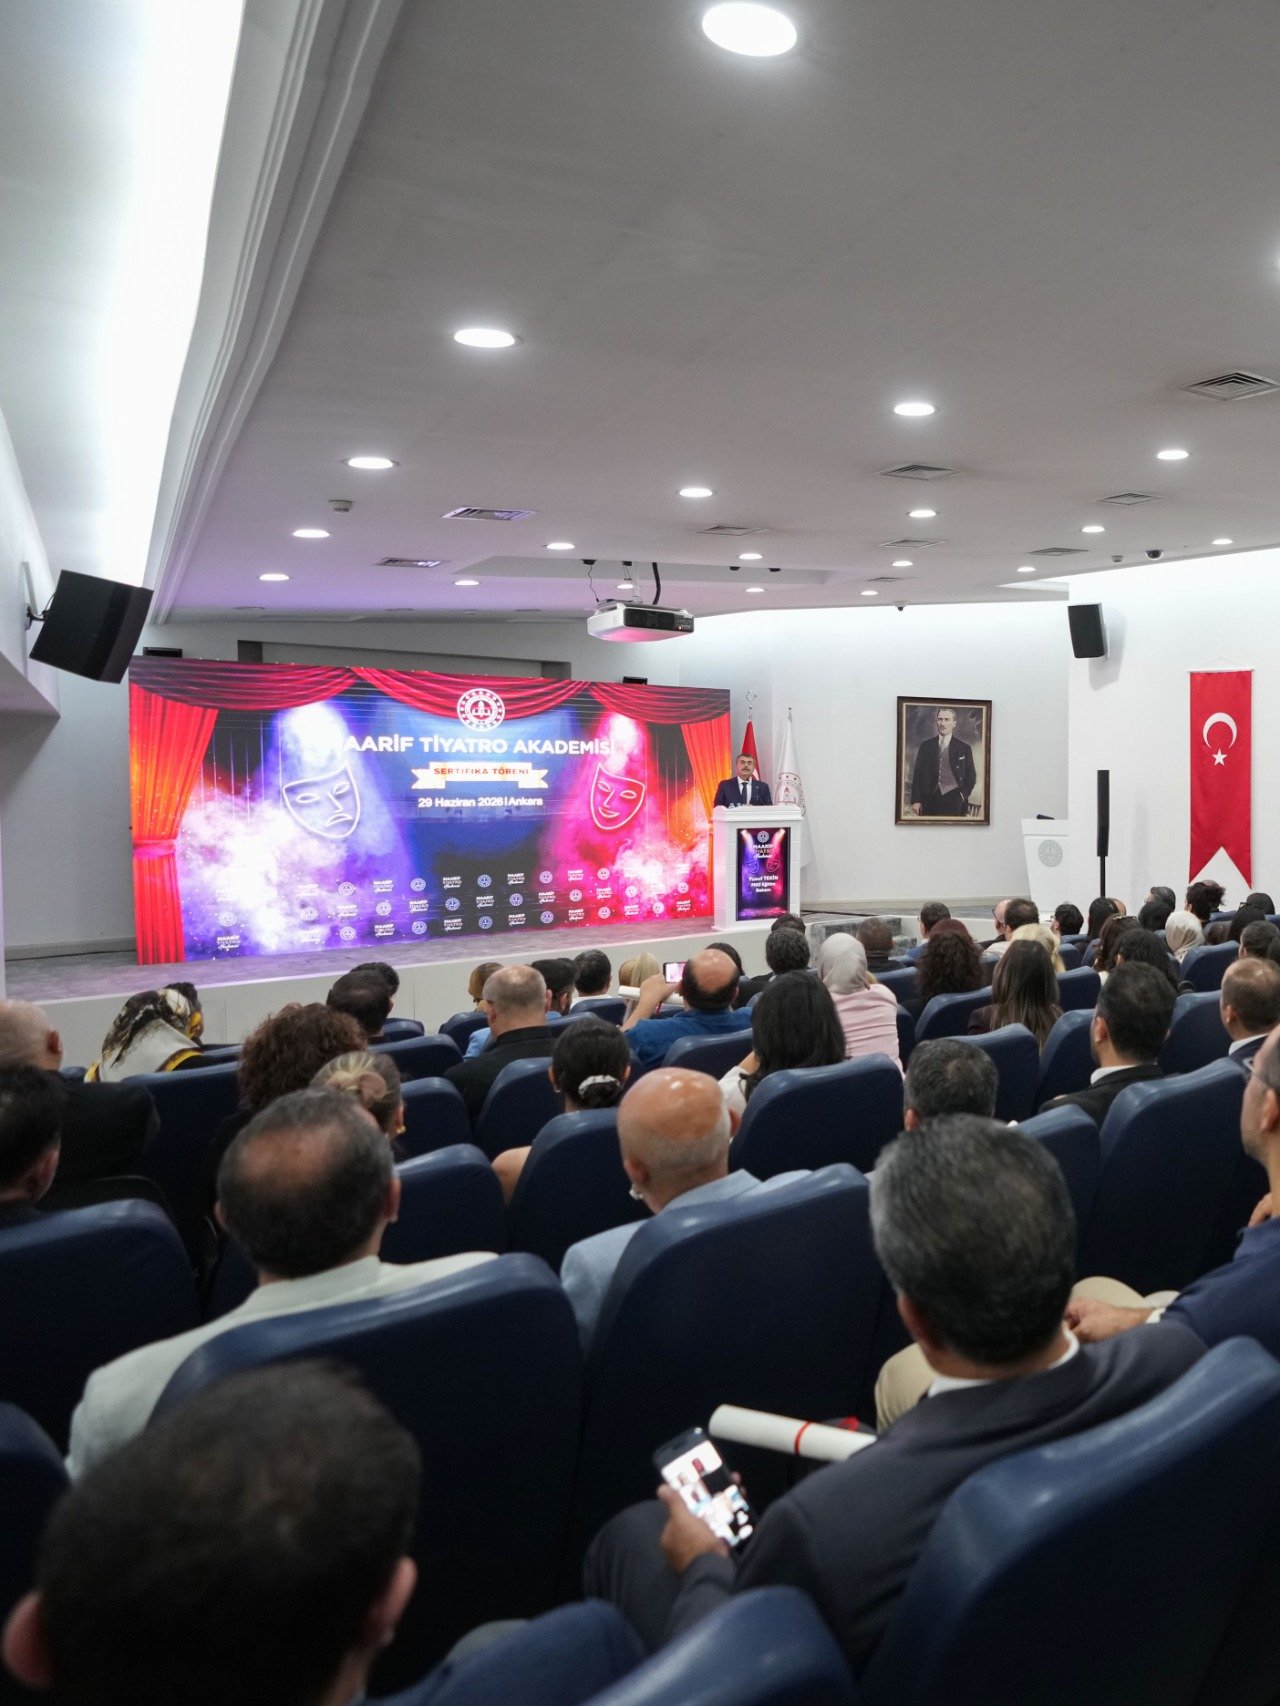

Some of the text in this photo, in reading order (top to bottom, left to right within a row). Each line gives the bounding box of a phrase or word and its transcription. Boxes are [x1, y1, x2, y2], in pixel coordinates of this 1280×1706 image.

[336, 734, 415, 752] AARİF
[419, 735, 508, 754] TİYATRO
[418, 798, 433, 808] 29
[435, 798, 476, 808] Haziran
[508, 797, 543, 806] Ankara
